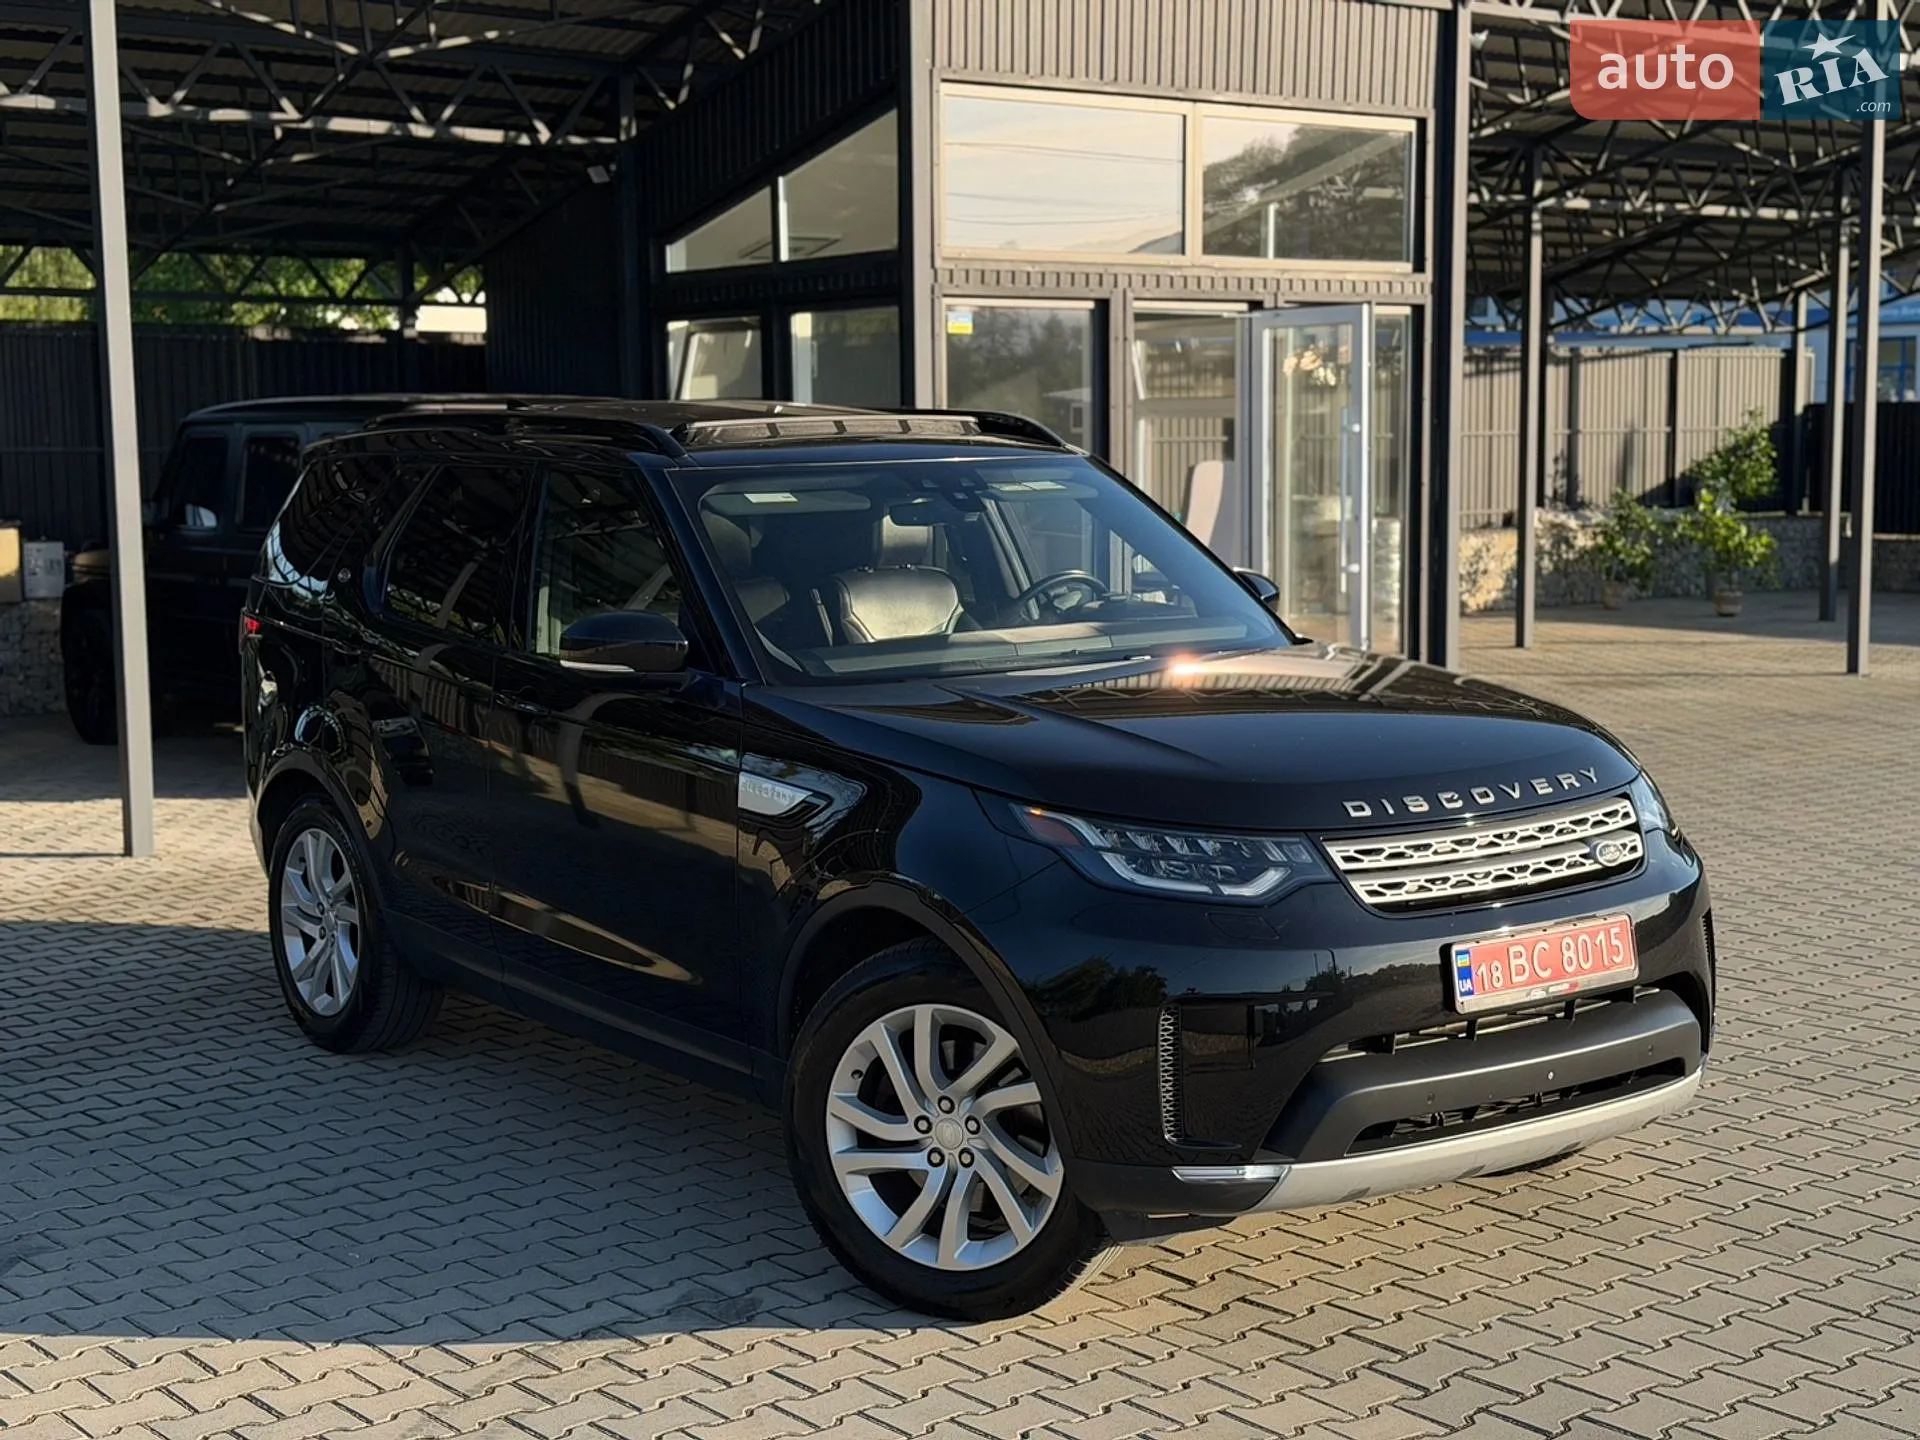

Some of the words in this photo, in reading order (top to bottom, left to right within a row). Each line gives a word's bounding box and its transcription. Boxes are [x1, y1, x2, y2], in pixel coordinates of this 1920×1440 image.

[1342, 766, 1600, 818] DISCOVERY
[1458, 979, 1475, 992] UA
[1477, 960, 1504, 992] 18
[1507, 942, 1552, 985] BC
[1560, 927, 1625, 974] 8015
